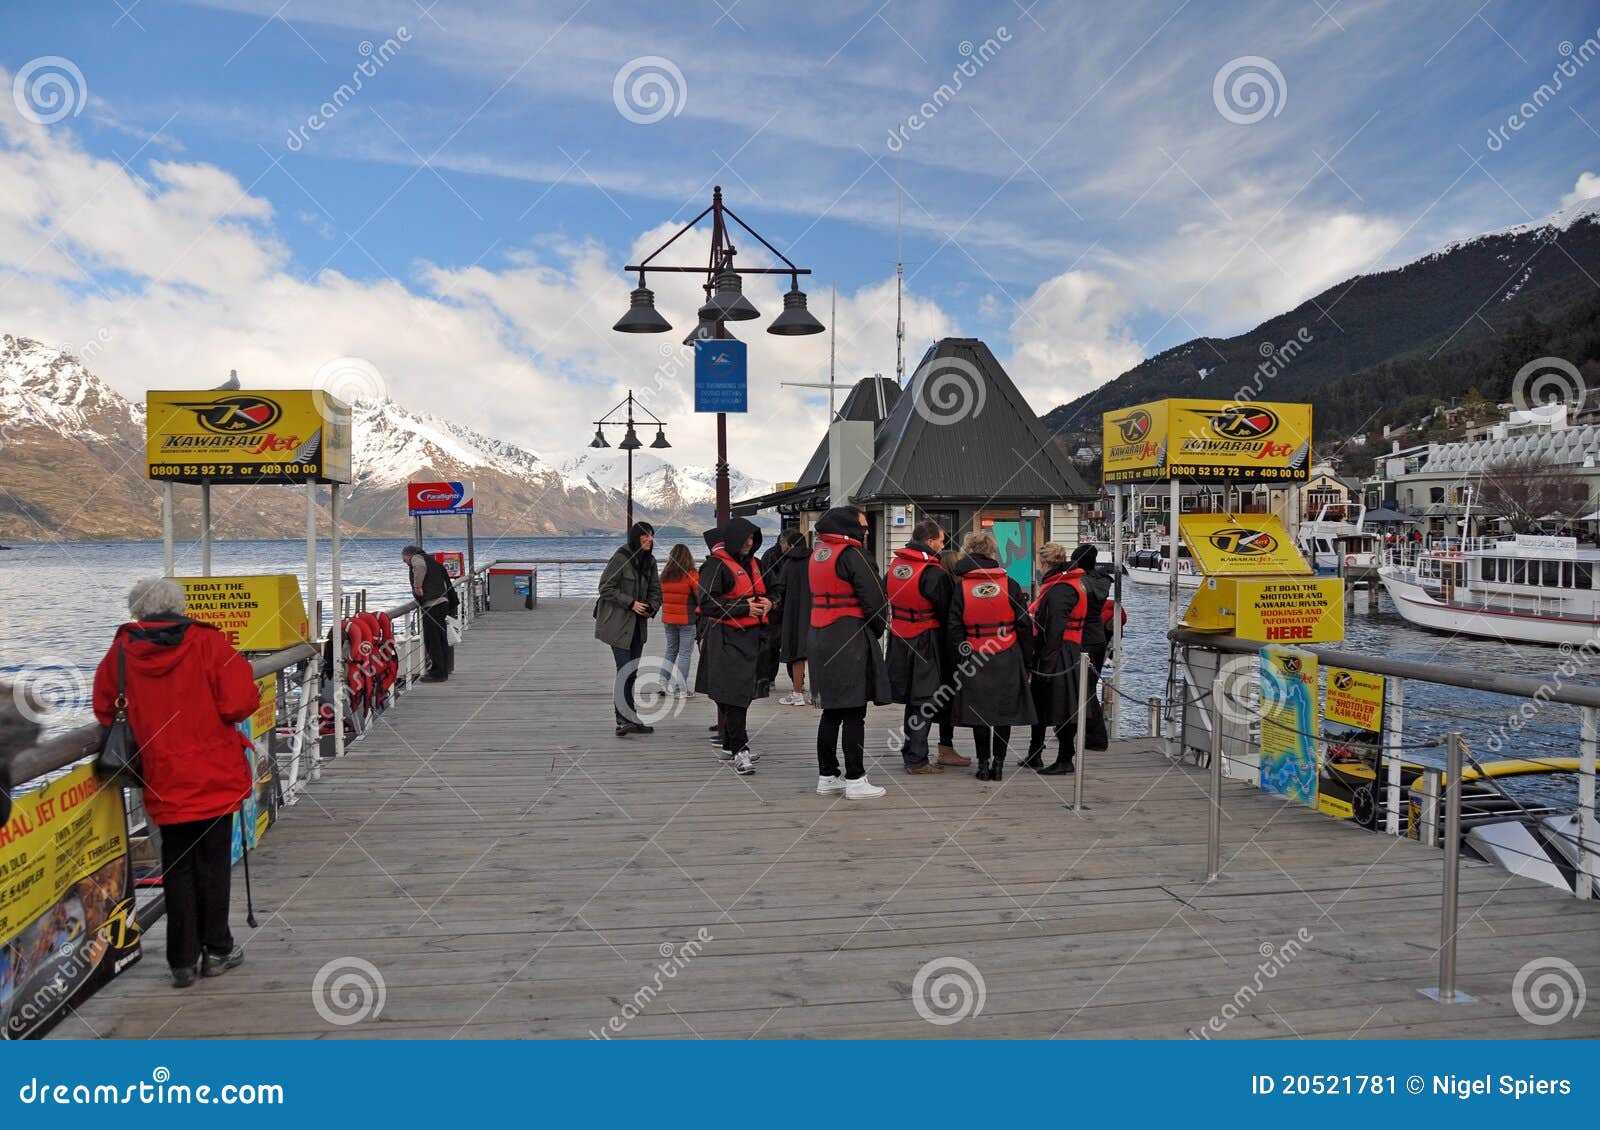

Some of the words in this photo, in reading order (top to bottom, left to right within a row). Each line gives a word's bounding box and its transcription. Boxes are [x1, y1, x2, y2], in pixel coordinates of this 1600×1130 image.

[165, 434, 264, 448] KAWARAU
[254, 433, 302, 455] Jet
[1184, 439, 1264, 452] KAWARAU
[1256, 441, 1294, 459] Jet
[151, 465, 180, 476] 0800
[183, 465, 198, 475] 52
[201, 464, 216, 475] 92
[219, 464, 234, 475] 72
[240, 466, 253, 475] or
[259, 464, 282, 474] 409
[284, 464, 300, 474] 00
[302, 464, 317, 474] 00
[1171, 466, 1195, 475] 0800
[1198, 467, 1211, 476] 52
[1213, 467, 1225, 476] 92
[1227, 467, 1240, 476] 72
[1260, 469, 1278, 478] 409
[1280, 469, 1292, 478] 00
[1293, 469, 1306, 478] 00
[193, 583, 221, 592] BOAT
[225, 583, 244, 591] THE
[1280, 584, 1301, 592] BOAT
[228, 592, 251, 600] AND
[1306, 592, 1323, 600] AND
[219, 601, 258, 609] RIVERS
[1254, 601, 1299, 609] KAWARAU
[1299, 600, 1328, 608] RIVERS
[228, 611, 251, 619] AND
[1260, 609, 1304, 617] BOOKINGS
[1305, 608, 1322, 616] AND
[1262, 617, 1320, 625] INFORMATION
[1266, 626, 1313, 640] HERE
[1335, 700, 1375, 714] SHOTOVER
[36, 797, 55, 827] JET
[87, 835, 120, 861] THRILLER
